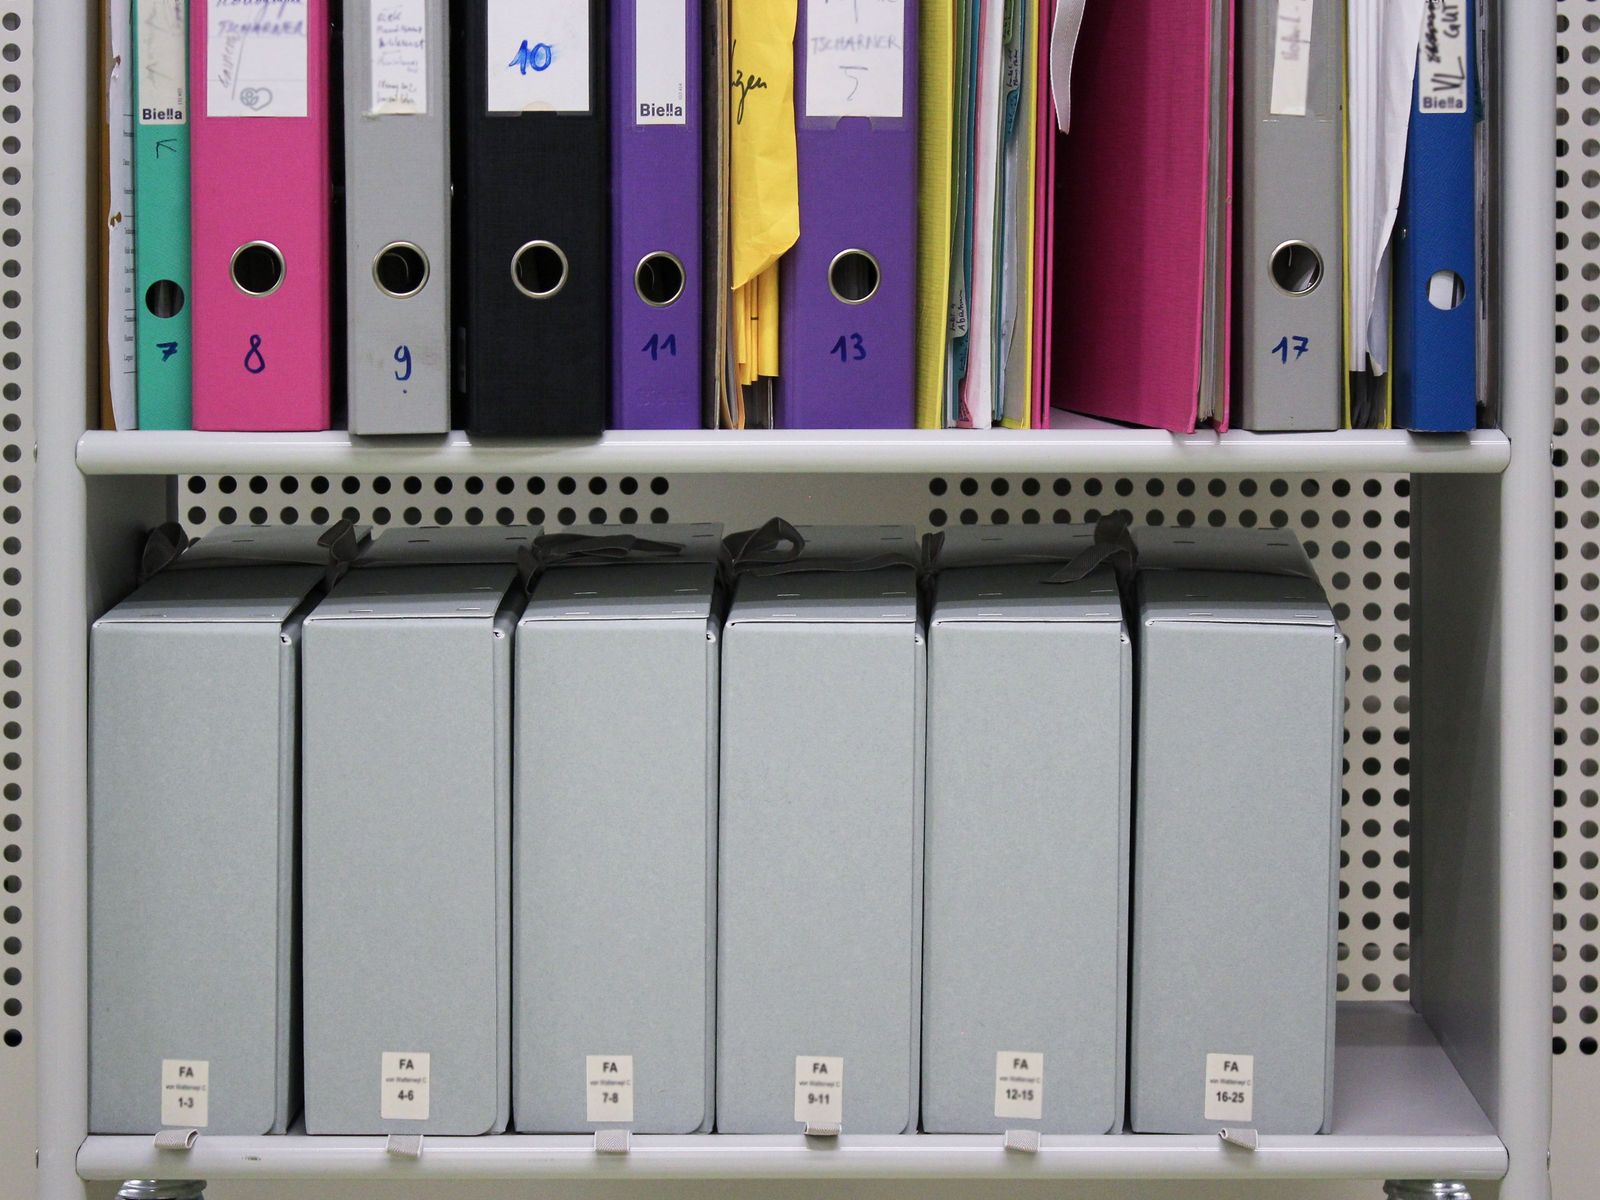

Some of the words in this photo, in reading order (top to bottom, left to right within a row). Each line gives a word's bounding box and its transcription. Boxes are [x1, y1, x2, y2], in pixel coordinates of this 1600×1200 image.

[508, 39, 553, 76] 10
[156, 341, 179, 362] 7
[641, 332, 677, 361] 11
[829, 331, 867, 363] 13
[1271, 335, 1309, 365] 17
[243, 334, 266, 375] 8
[398, 1058, 414, 1070] FA
[602, 1062, 618, 1073] FA
[812, 1062, 828, 1074] FA
[1013, 1058, 1029, 1070] FA
[1223, 1060, 1239, 1072] FA
[178, 1066, 194, 1078] FA
[397, 1089, 415, 1101] 4-6
[602, 1092, 619, 1103] 7-8
[807, 1093, 830, 1105] 9-11
[1006, 1088, 1034, 1101] 12-15
[1216, 1091, 1245, 1103] 16-25
[178, 1097, 194, 1108] 1-3
